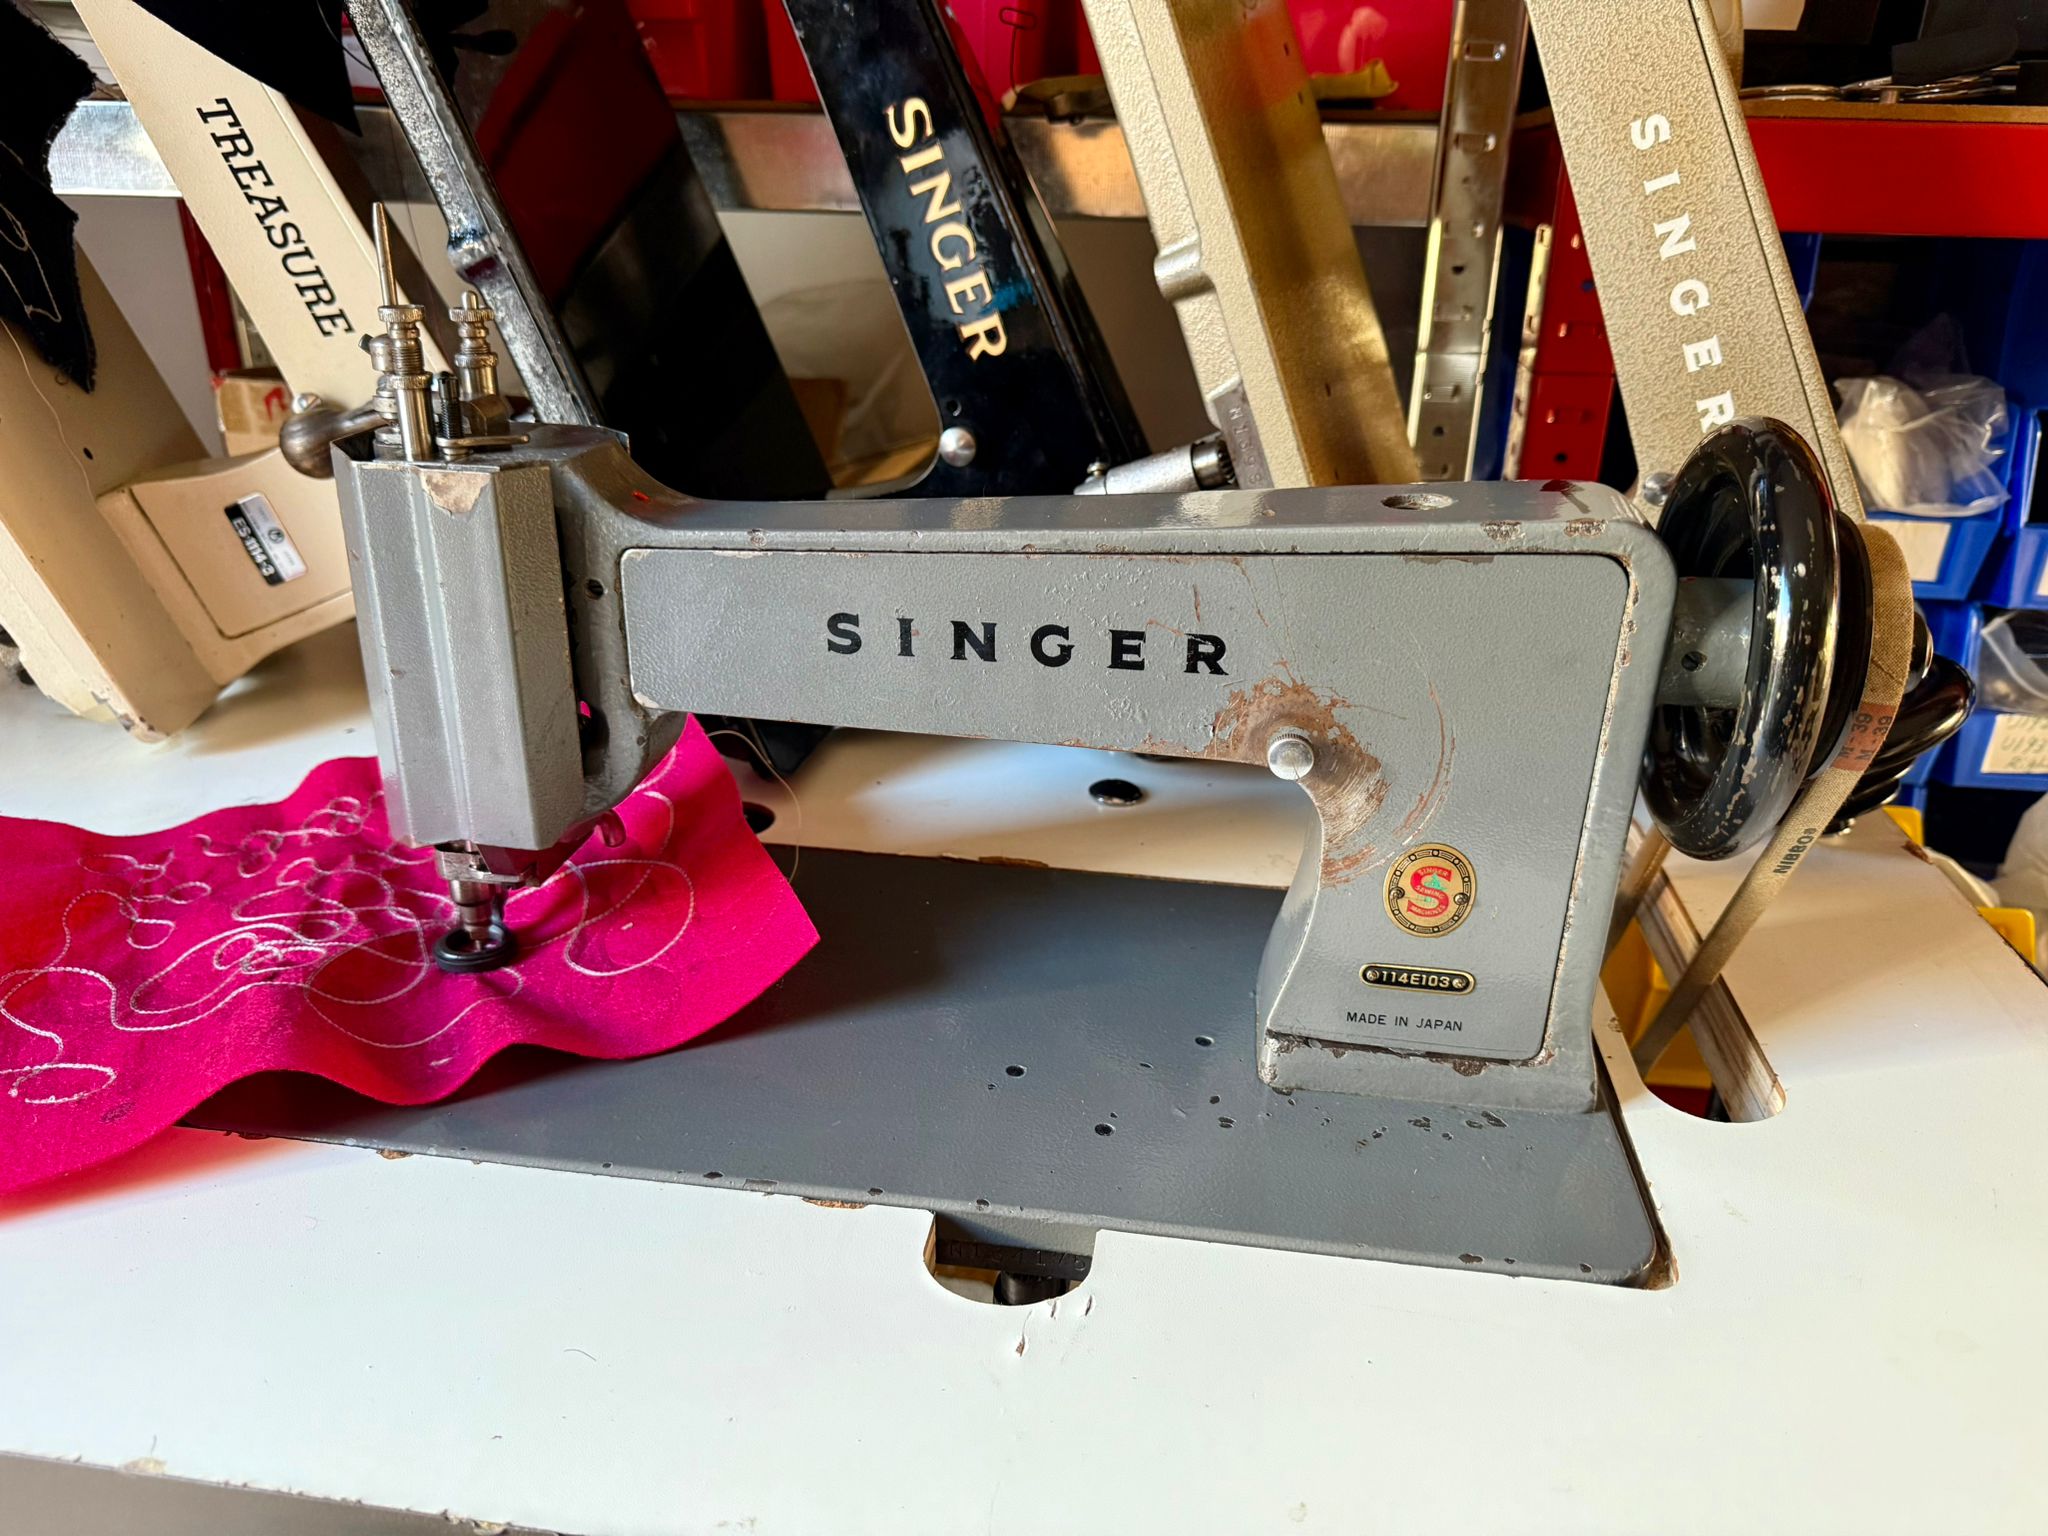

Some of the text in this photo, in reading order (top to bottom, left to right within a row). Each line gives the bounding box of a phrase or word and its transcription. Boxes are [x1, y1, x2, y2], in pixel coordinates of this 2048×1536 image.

[196, 98, 355, 337] TREASURE
[884, 96, 1008, 362] SINGER
[1630, 113, 1735, 433] SINGER
[827, 612, 1229, 675] SINGER
[1346, 1011, 1462, 1031] MADE IN JAPAN
[1381, 971, 1450, 988] 114E103
